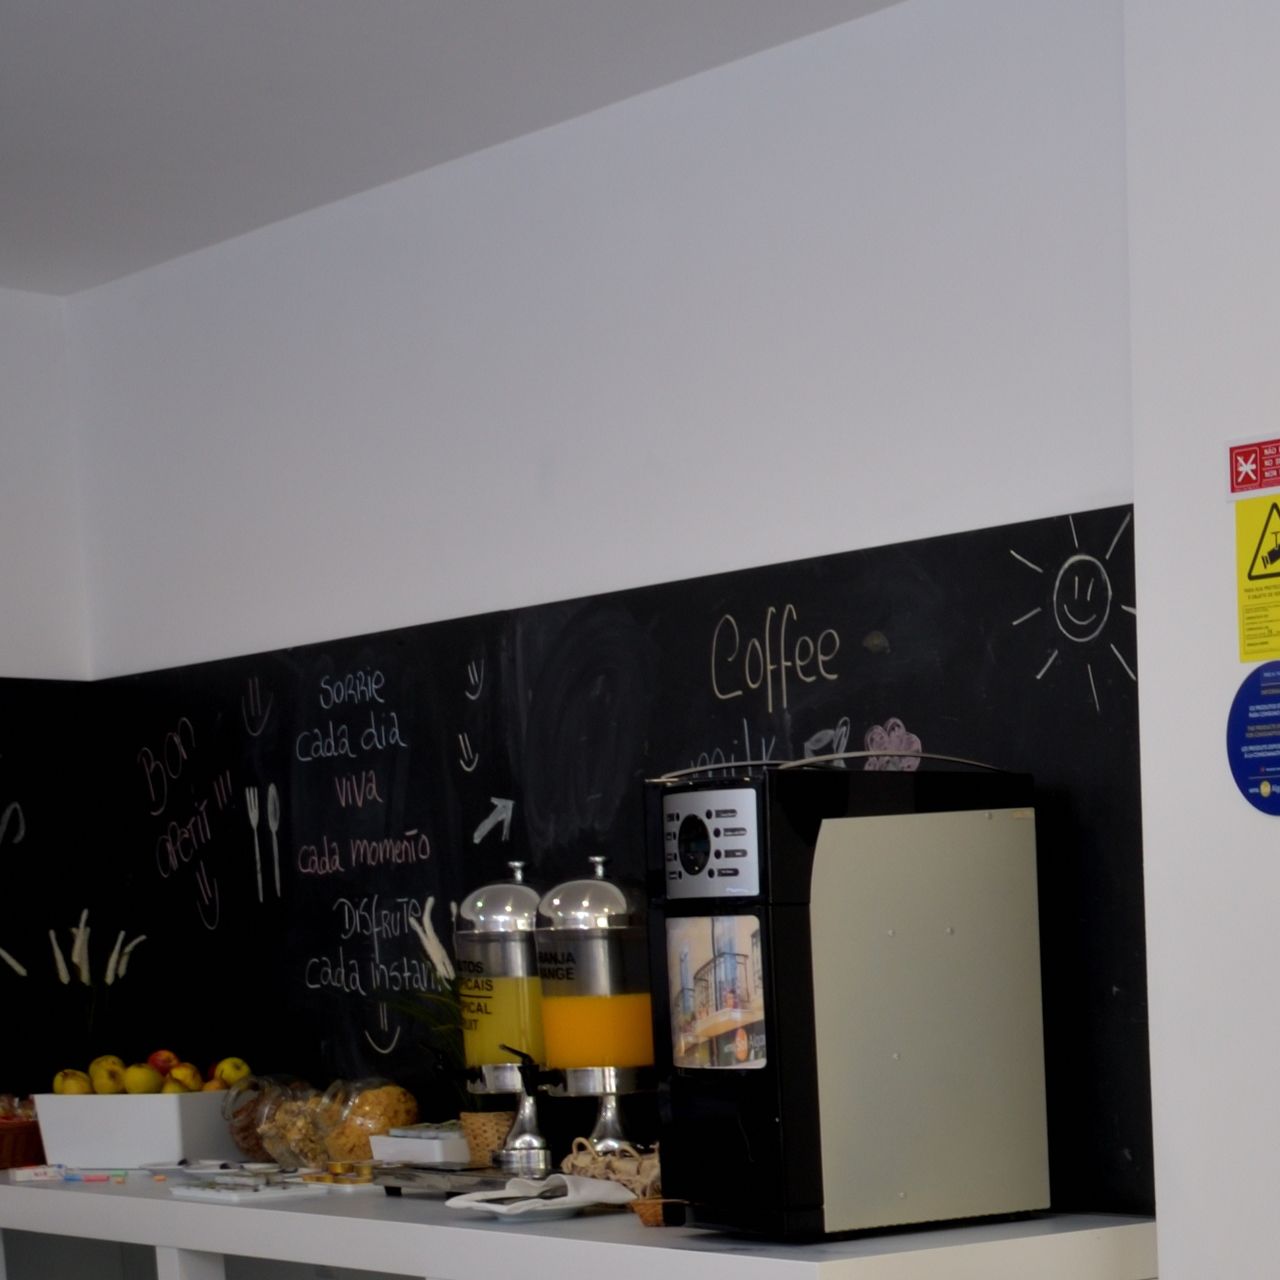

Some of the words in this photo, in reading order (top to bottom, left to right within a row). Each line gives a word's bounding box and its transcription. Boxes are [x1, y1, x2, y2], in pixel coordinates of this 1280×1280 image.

[711, 603, 840, 713] Coffee
[136, 716, 196, 817] Bon
[360, 709, 408, 750] dia
